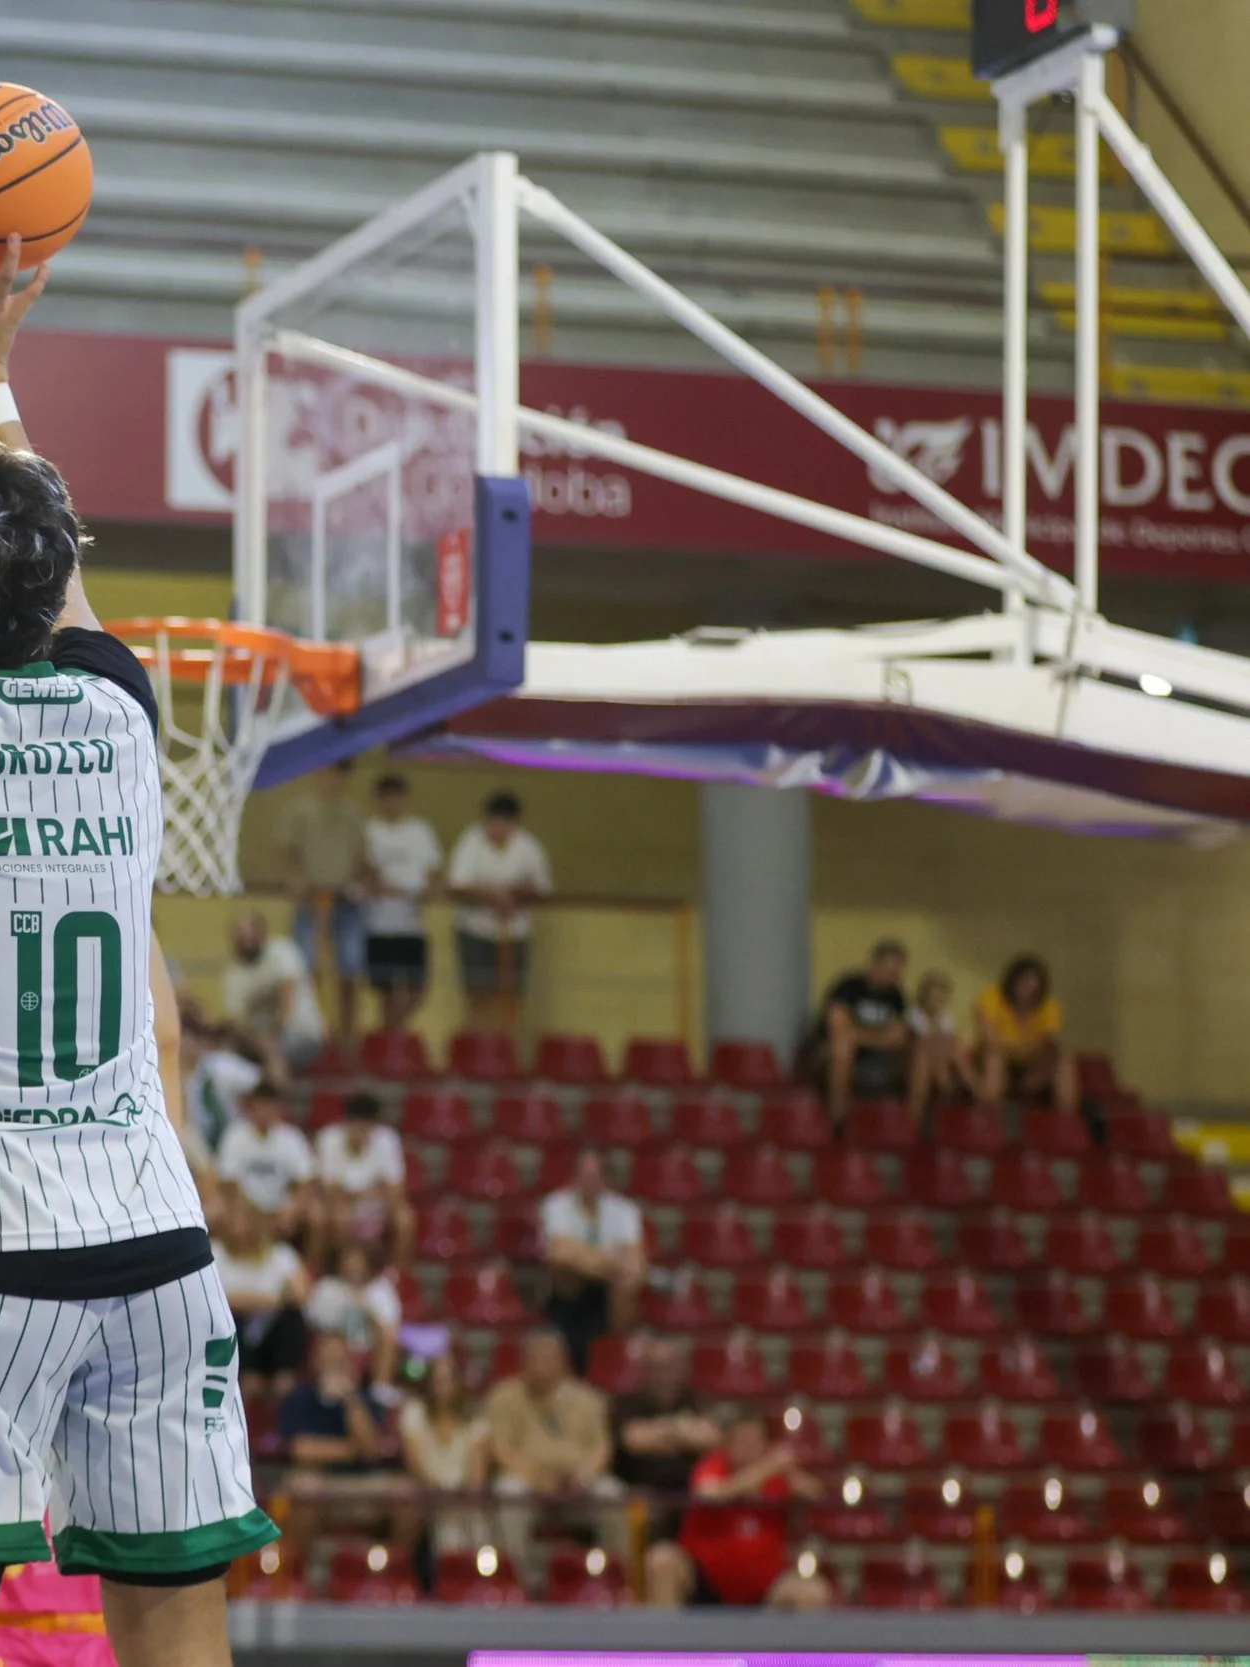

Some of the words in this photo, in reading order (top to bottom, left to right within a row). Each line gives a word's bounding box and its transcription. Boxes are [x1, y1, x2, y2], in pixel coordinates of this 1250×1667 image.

[36, 816, 133, 856] RAHI
[45, 863, 106, 873] INTEGRALES
[13, 914, 40, 934] CCB
[11, 911, 122, 1087] 10
